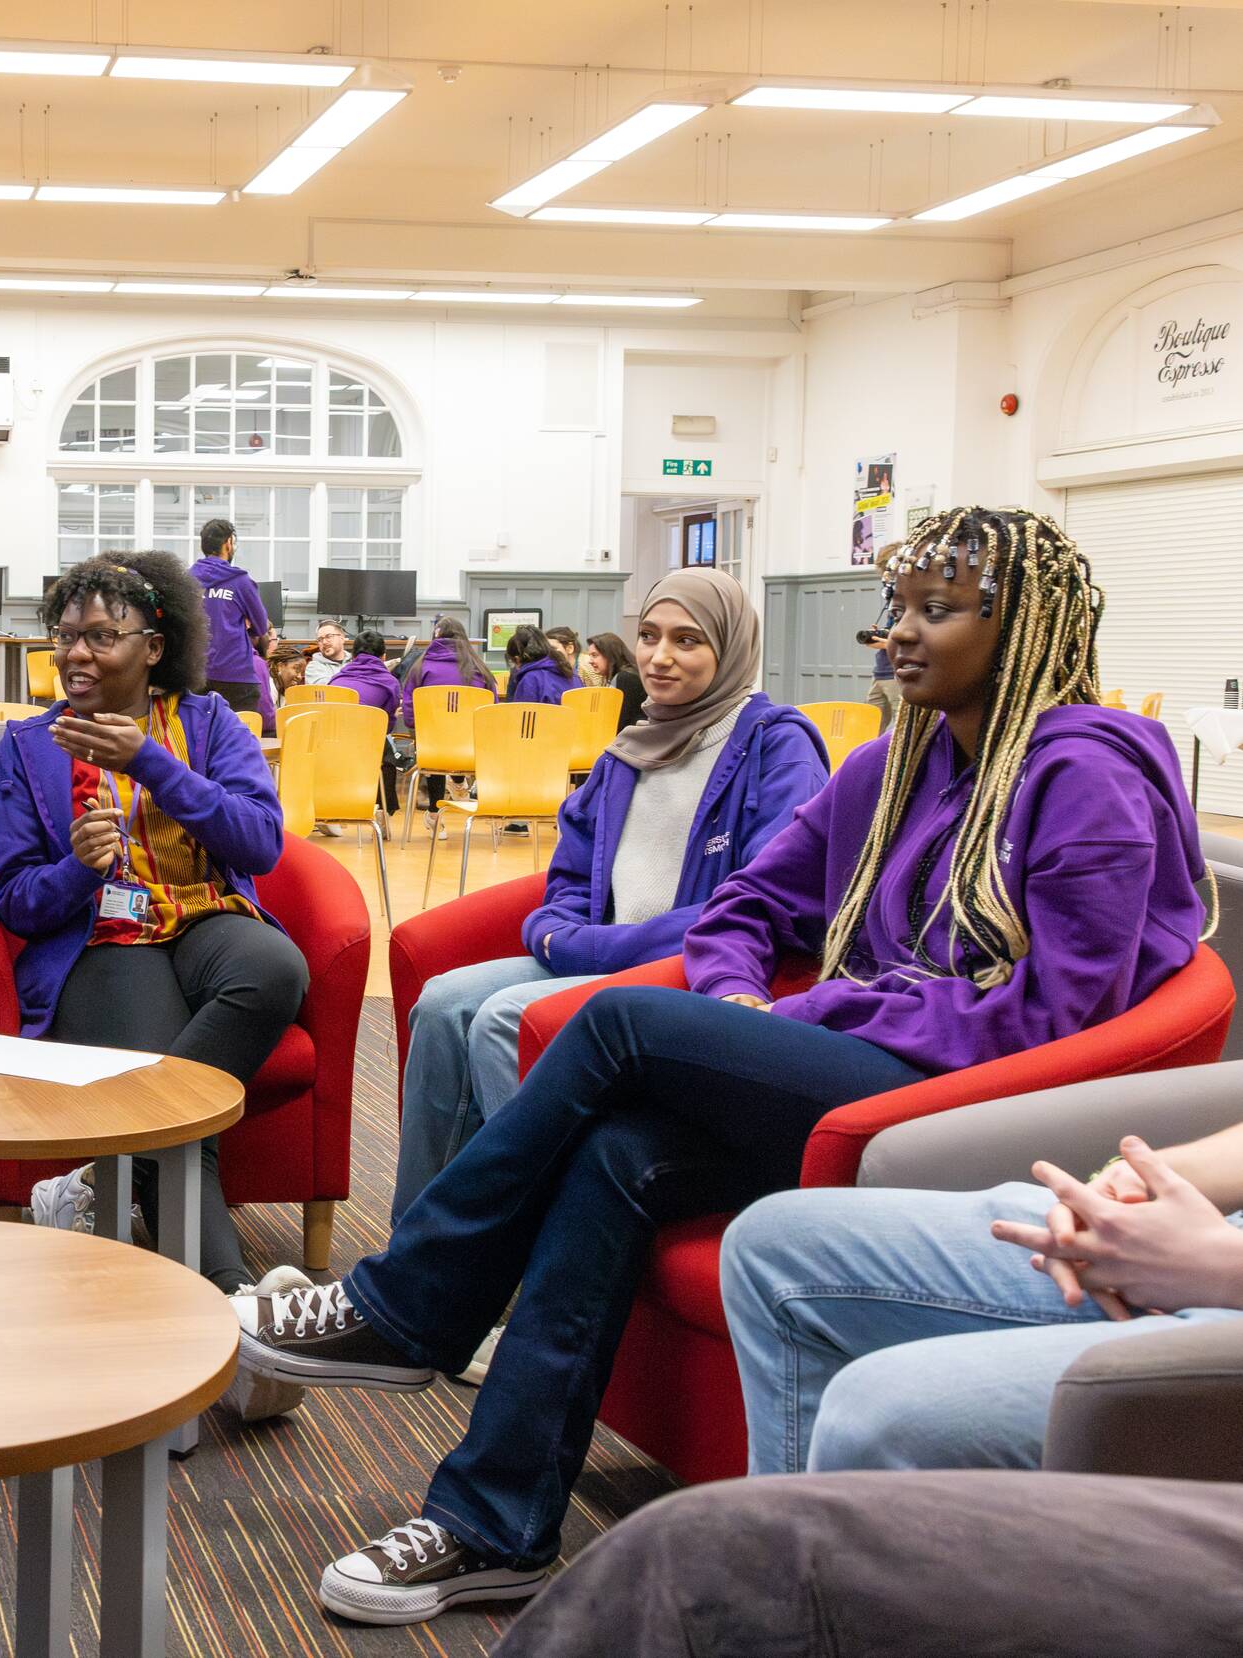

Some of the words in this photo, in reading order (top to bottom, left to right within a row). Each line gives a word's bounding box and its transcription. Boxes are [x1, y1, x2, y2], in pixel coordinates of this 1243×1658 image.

[1154, 318, 1230, 352] Boutique
[1158, 352, 1224, 388] Espresso
[208, 588, 234, 600] ME
